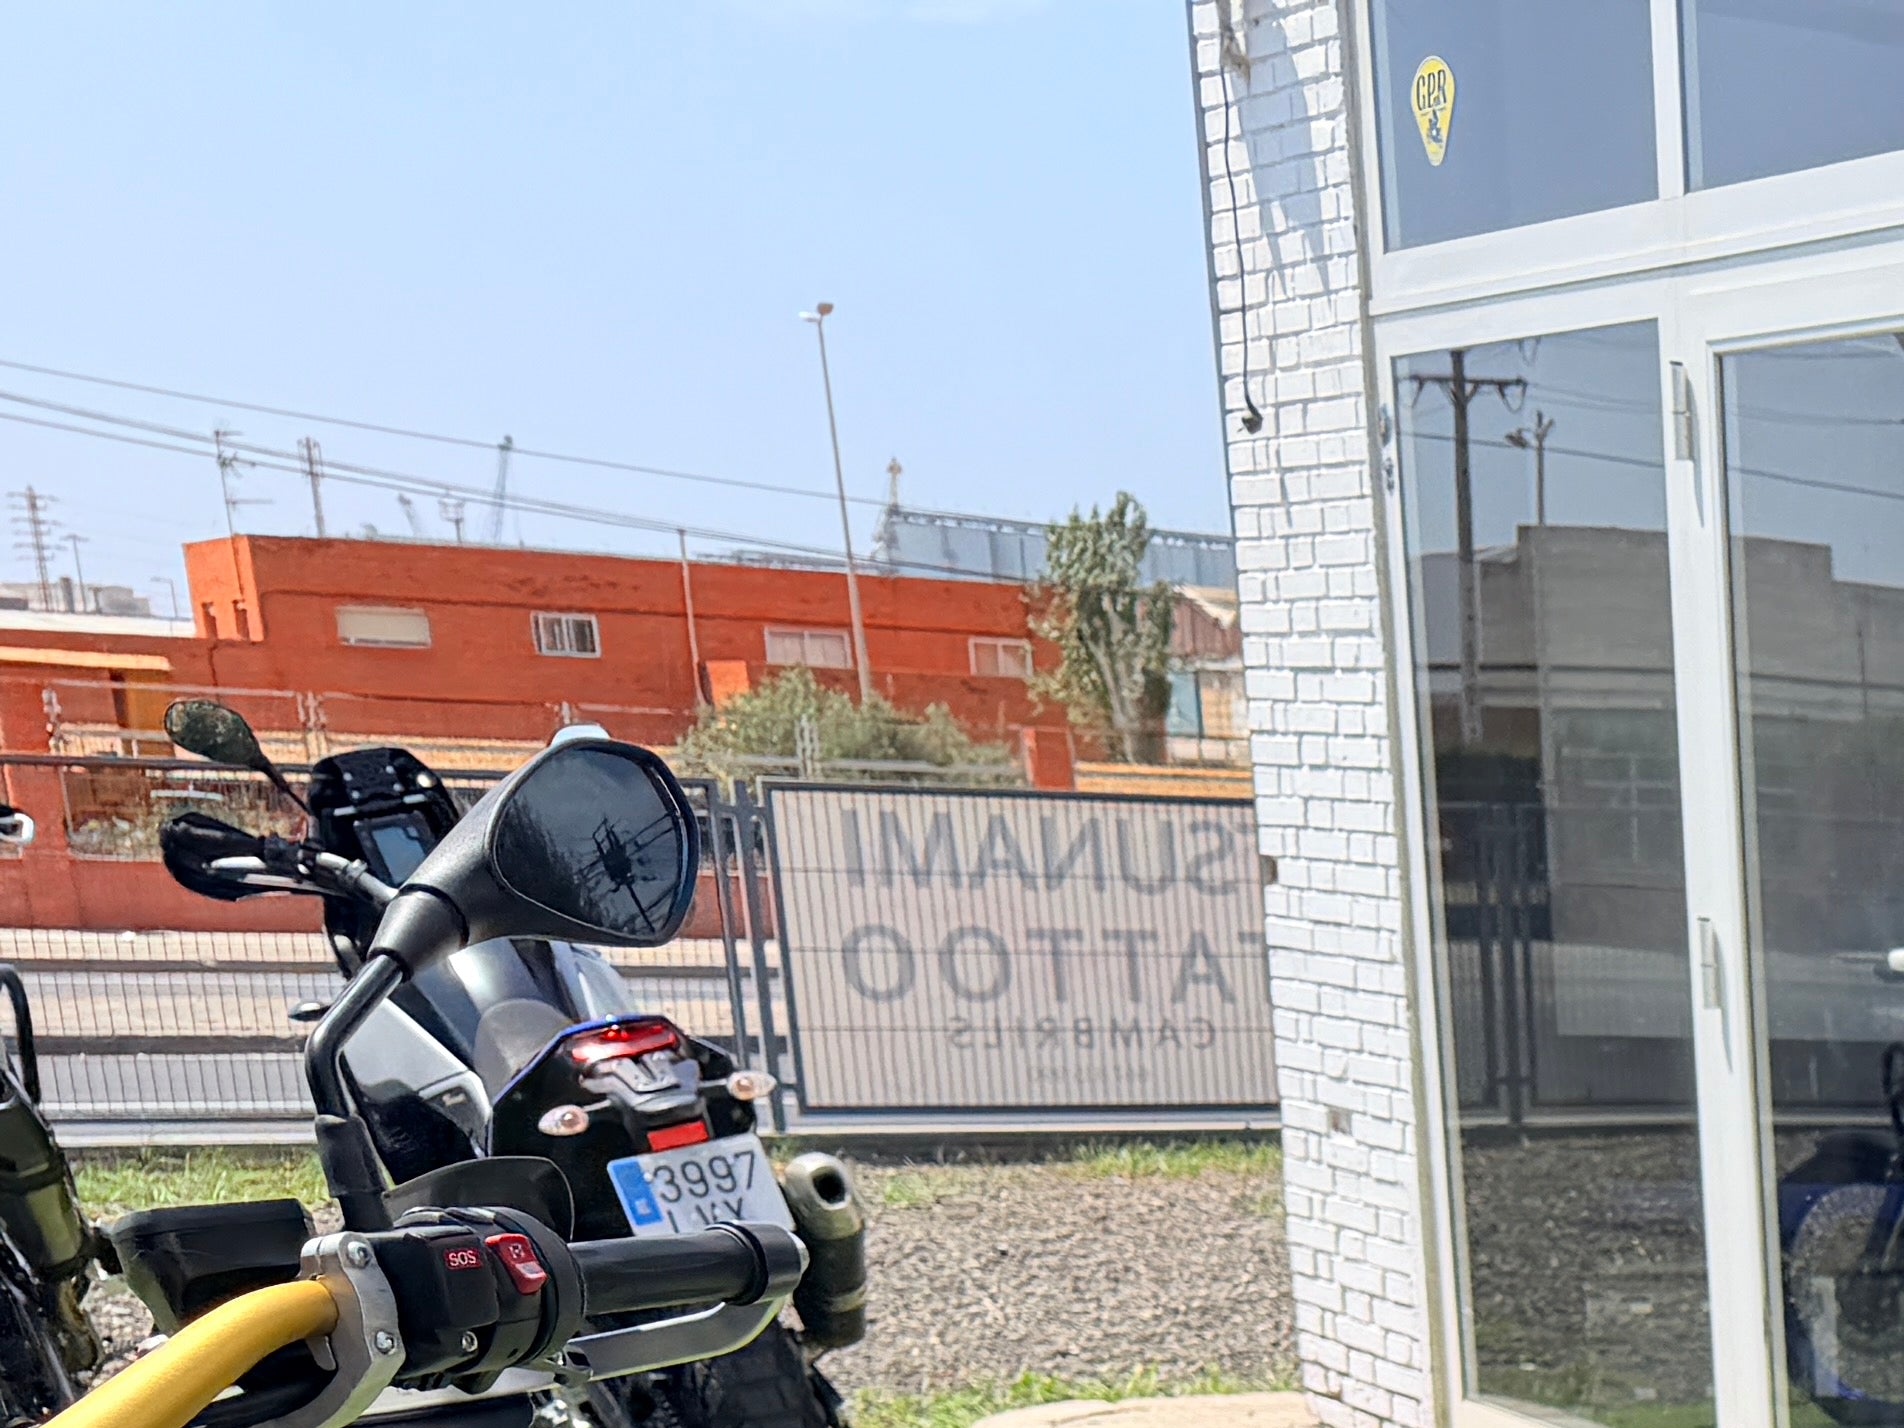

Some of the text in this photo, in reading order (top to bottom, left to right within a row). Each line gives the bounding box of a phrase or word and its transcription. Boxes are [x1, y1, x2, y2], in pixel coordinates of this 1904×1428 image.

[1416, 69, 1447, 111] GPR
[654, 1150, 755, 1203] 3997
[448, 1250, 477, 1267] SOS
